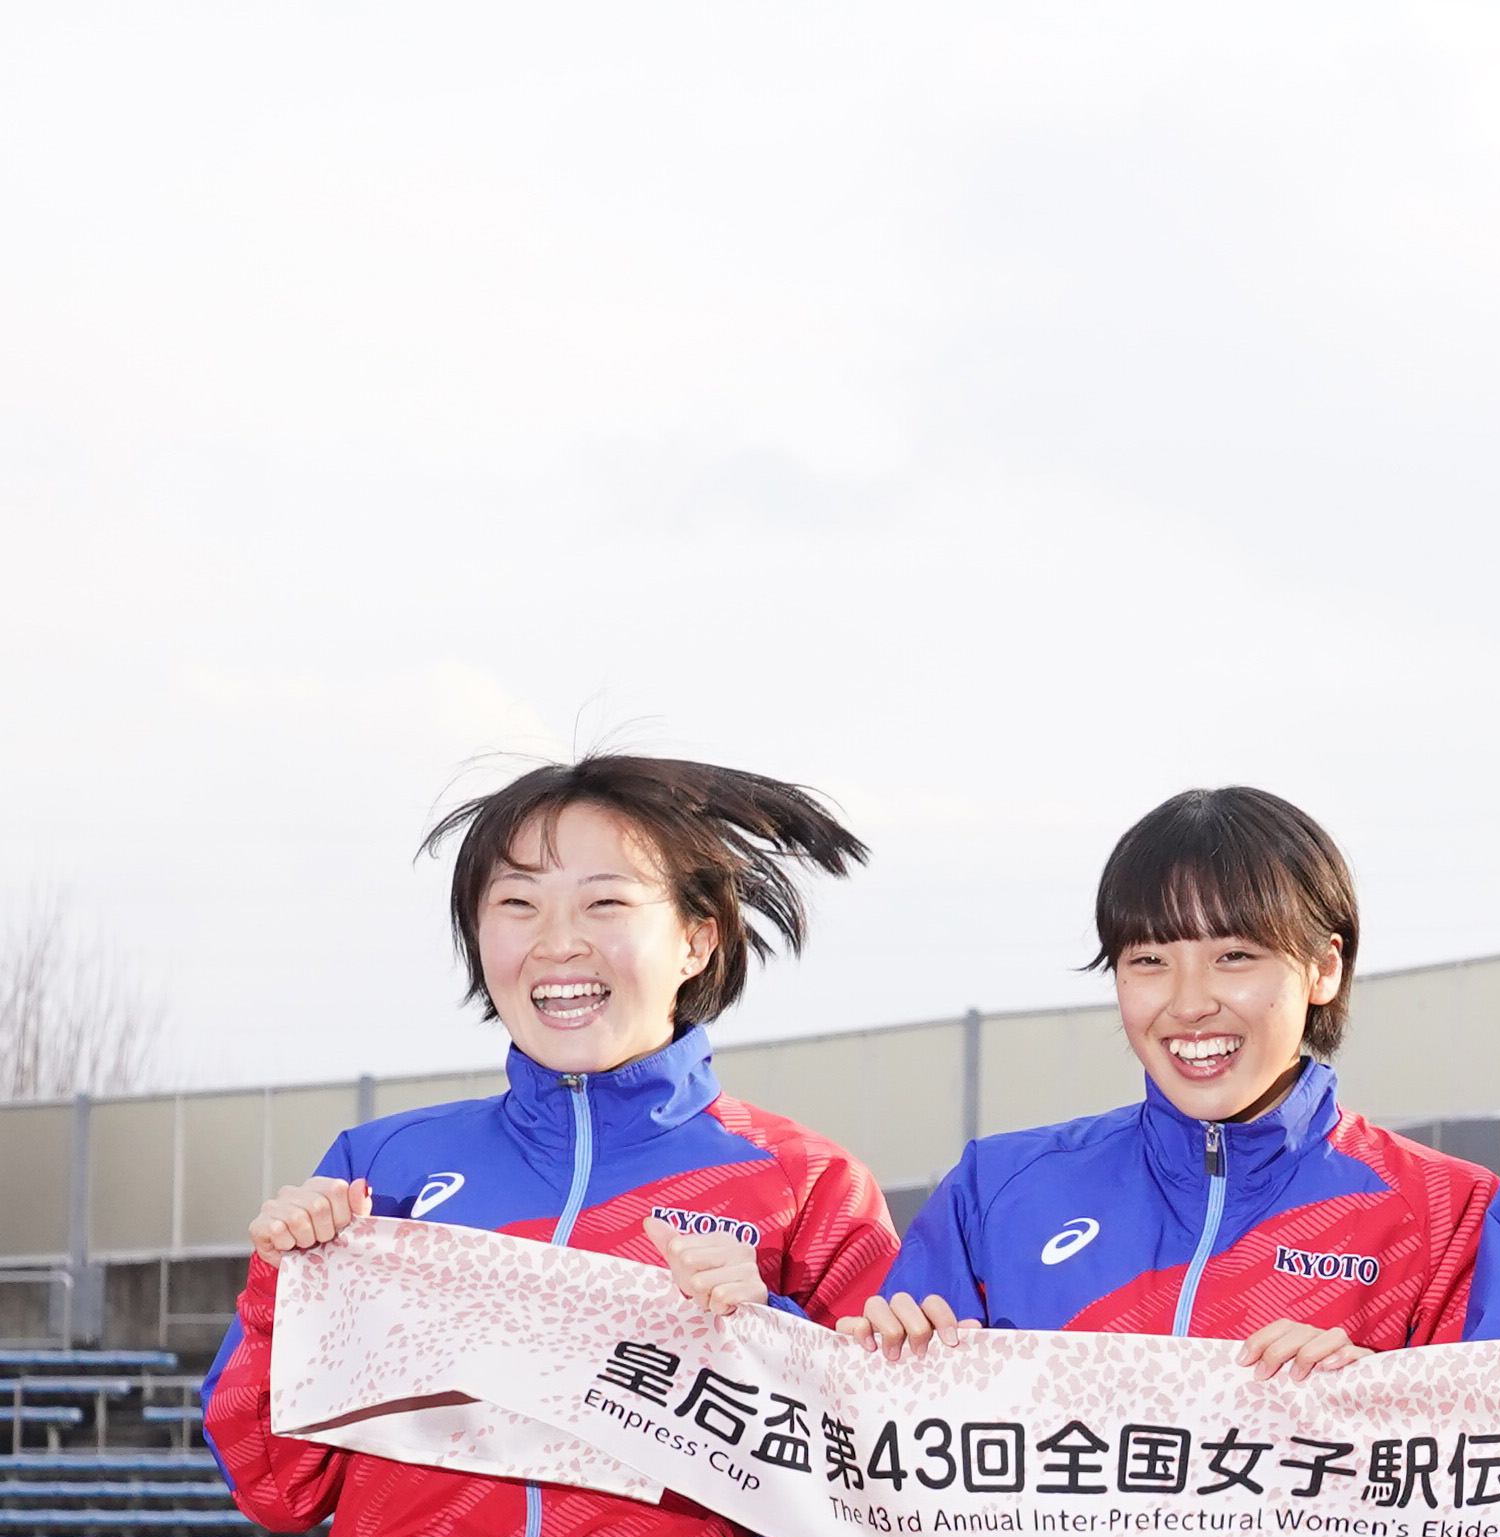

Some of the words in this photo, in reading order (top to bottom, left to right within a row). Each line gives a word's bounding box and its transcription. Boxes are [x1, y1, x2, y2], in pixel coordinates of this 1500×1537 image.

[1275, 1245, 1379, 1286] KYOTO
[709, 1451, 761, 1491] Cup
[829, 1496, 863, 1525] The
[934, 1509, 1023, 1532] Annual
[1033, 1508, 1263, 1533] Inter-Prefectural
